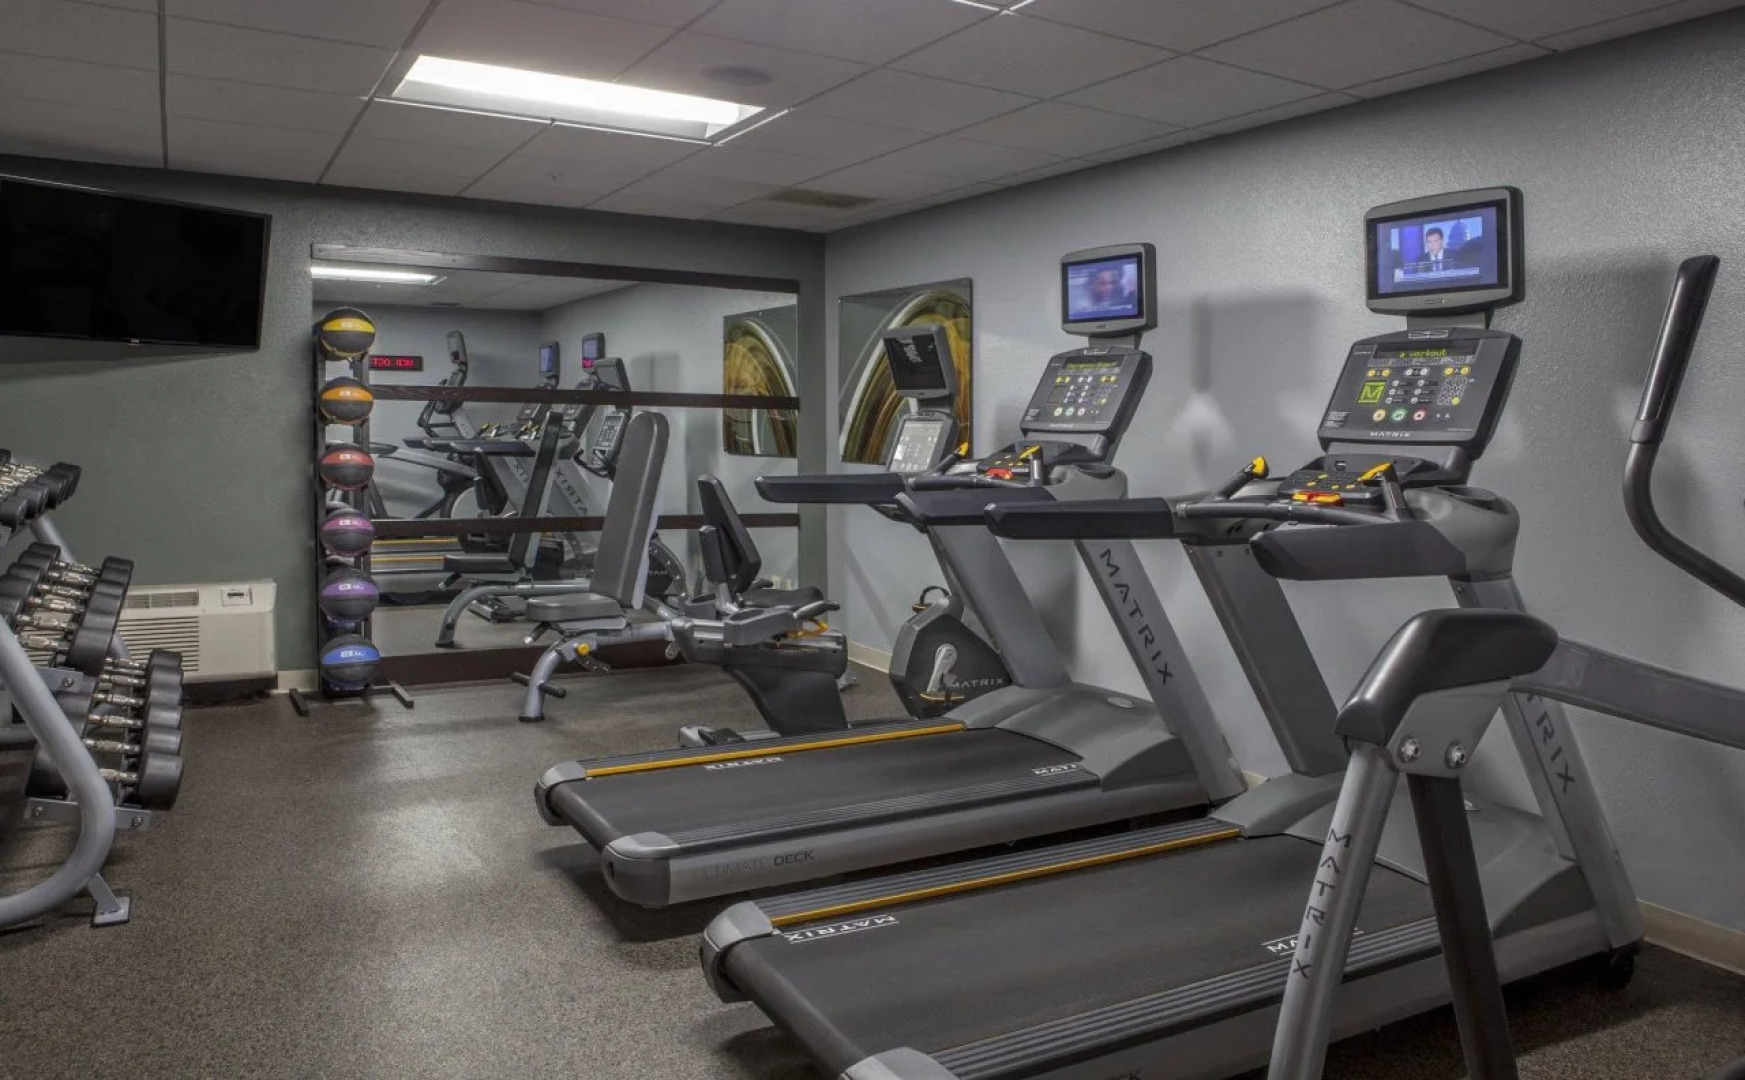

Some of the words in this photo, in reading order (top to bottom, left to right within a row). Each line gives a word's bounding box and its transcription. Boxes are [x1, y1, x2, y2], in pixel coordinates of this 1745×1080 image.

[1409, 348, 1447, 357] workout
[1101, 548, 1174, 686] MATRIX
[773, 850, 815, 867] DECK
[1292, 828, 1352, 979] MATRIX
[787, 915, 896, 941] MATRIX
